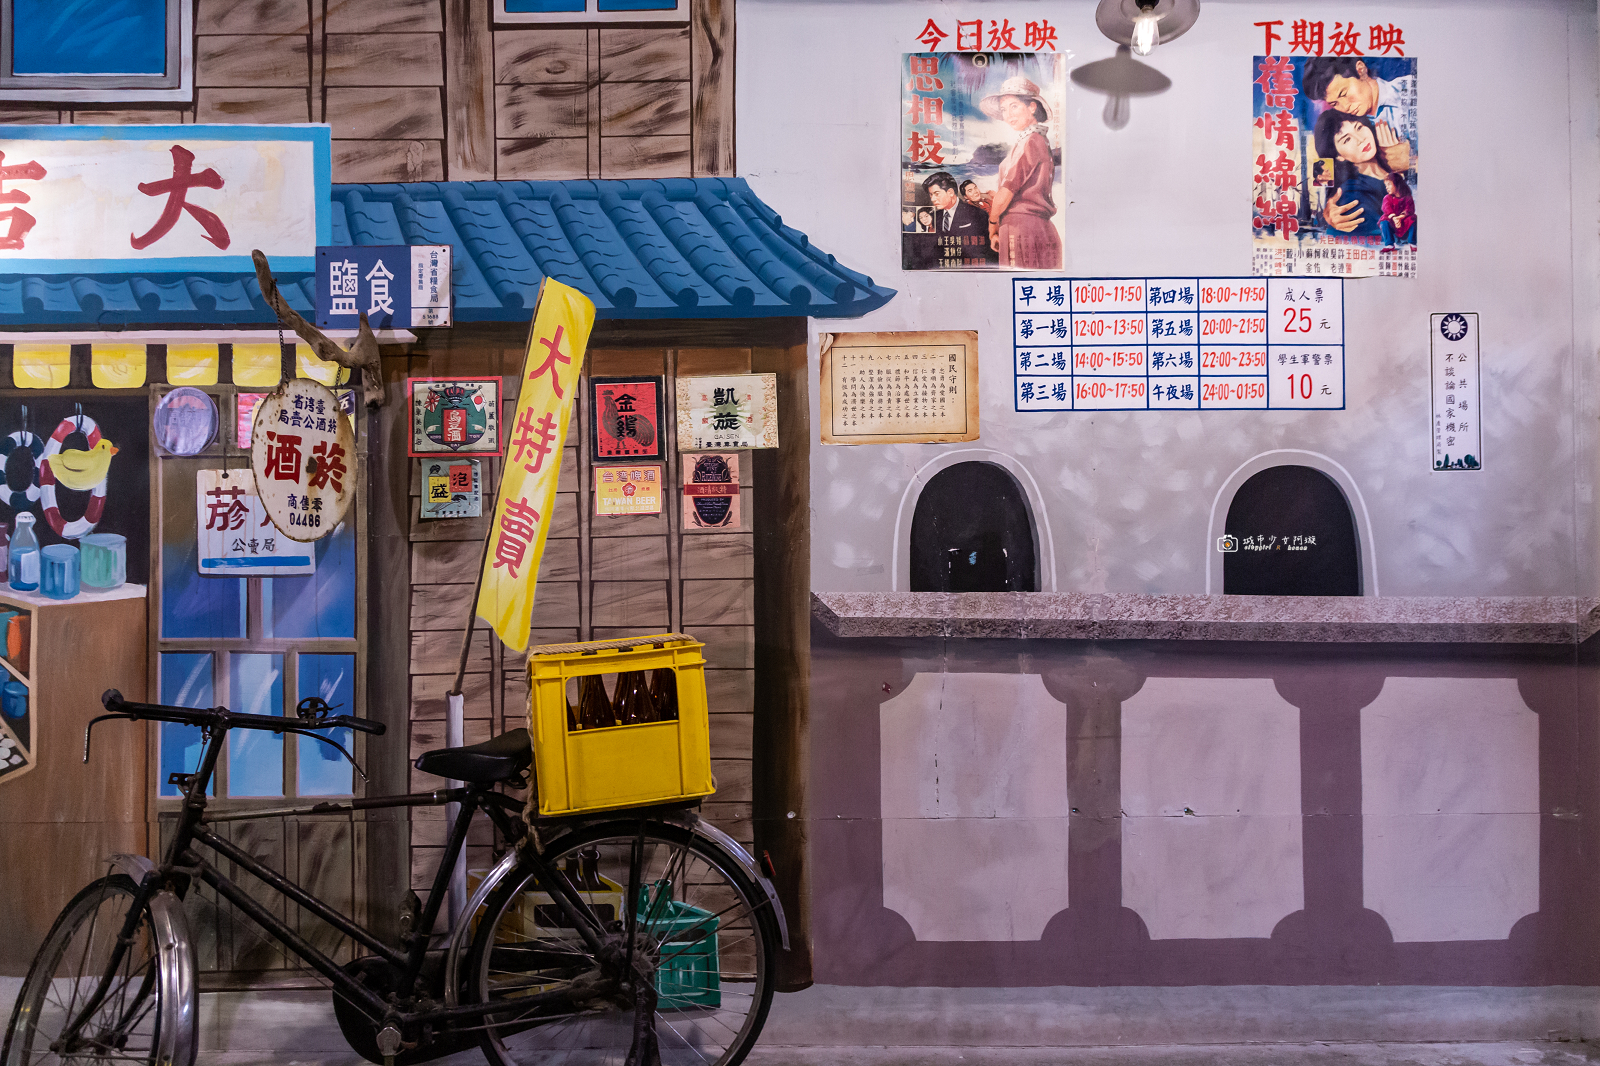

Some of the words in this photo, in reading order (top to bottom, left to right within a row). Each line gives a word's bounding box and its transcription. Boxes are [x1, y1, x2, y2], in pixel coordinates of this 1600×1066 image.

[915, 19, 1058, 52] 今日放映
[1254, 19, 1405, 57] 下期放映
[905, 56, 945, 165] 思相枝
[1253, 56, 1299, 241] 舊情綿綿
[329, 259, 395, 317] 食鹽
[1018, 285, 1065, 307] 早場
[1074, 286, 1142, 303] 10:00~11:50
[1149, 286, 1195, 306] 第四場
[1201, 286, 1265, 303] 18:00~19:50
[1283, 287, 1324, 302] 成人票
[1020, 318, 1068, 339] 第一場
[1074, 318, 1144, 337] 12:00~13:50
[1151, 318, 1194, 338] 第五場
[1202, 318, 1265, 336] 20:00~21:50
[1283, 307, 1312, 334] 25
[1319, 319, 1331, 330] 元
[1019, 351, 1066, 370] 第二場
[1074, 351, 1143, 369] 14:00~15:50
[1151, 351, 1194, 370] 第六場
[1201, 351, 1266, 368] 22:00~23:50
[1277, 353, 1333, 366] 學生軍警票
[1019, 381, 1066, 402] 第三場
[1075, 382, 1145, 401] 16:00~17:50
[1152, 383, 1195, 402] 午夜場
[1202, 383, 1265, 401] 24:00~01:50
[1286, 373, 1313, 400] 10
[1320, 384, 1332, 396] 元
[1444, 353, 1456, 447] 不談論國家機密
[1457, 353, 1470, 433] 公共場所
[277, 409, 338, 434] 菸酒公賣局
[713, 387, 741, 431] 凱旋
[264, 430, 347, 494] 菸酒
[492, 324, 571, 580] 大特賣
[287, 493, 323, 513] 零售商
[602, 497, 633, 506] TAIWAN
[636, 496, 656, 505] BEER
[289, 513, 321, 528] 04486
[231, 538, 275, 555] 公賣局
